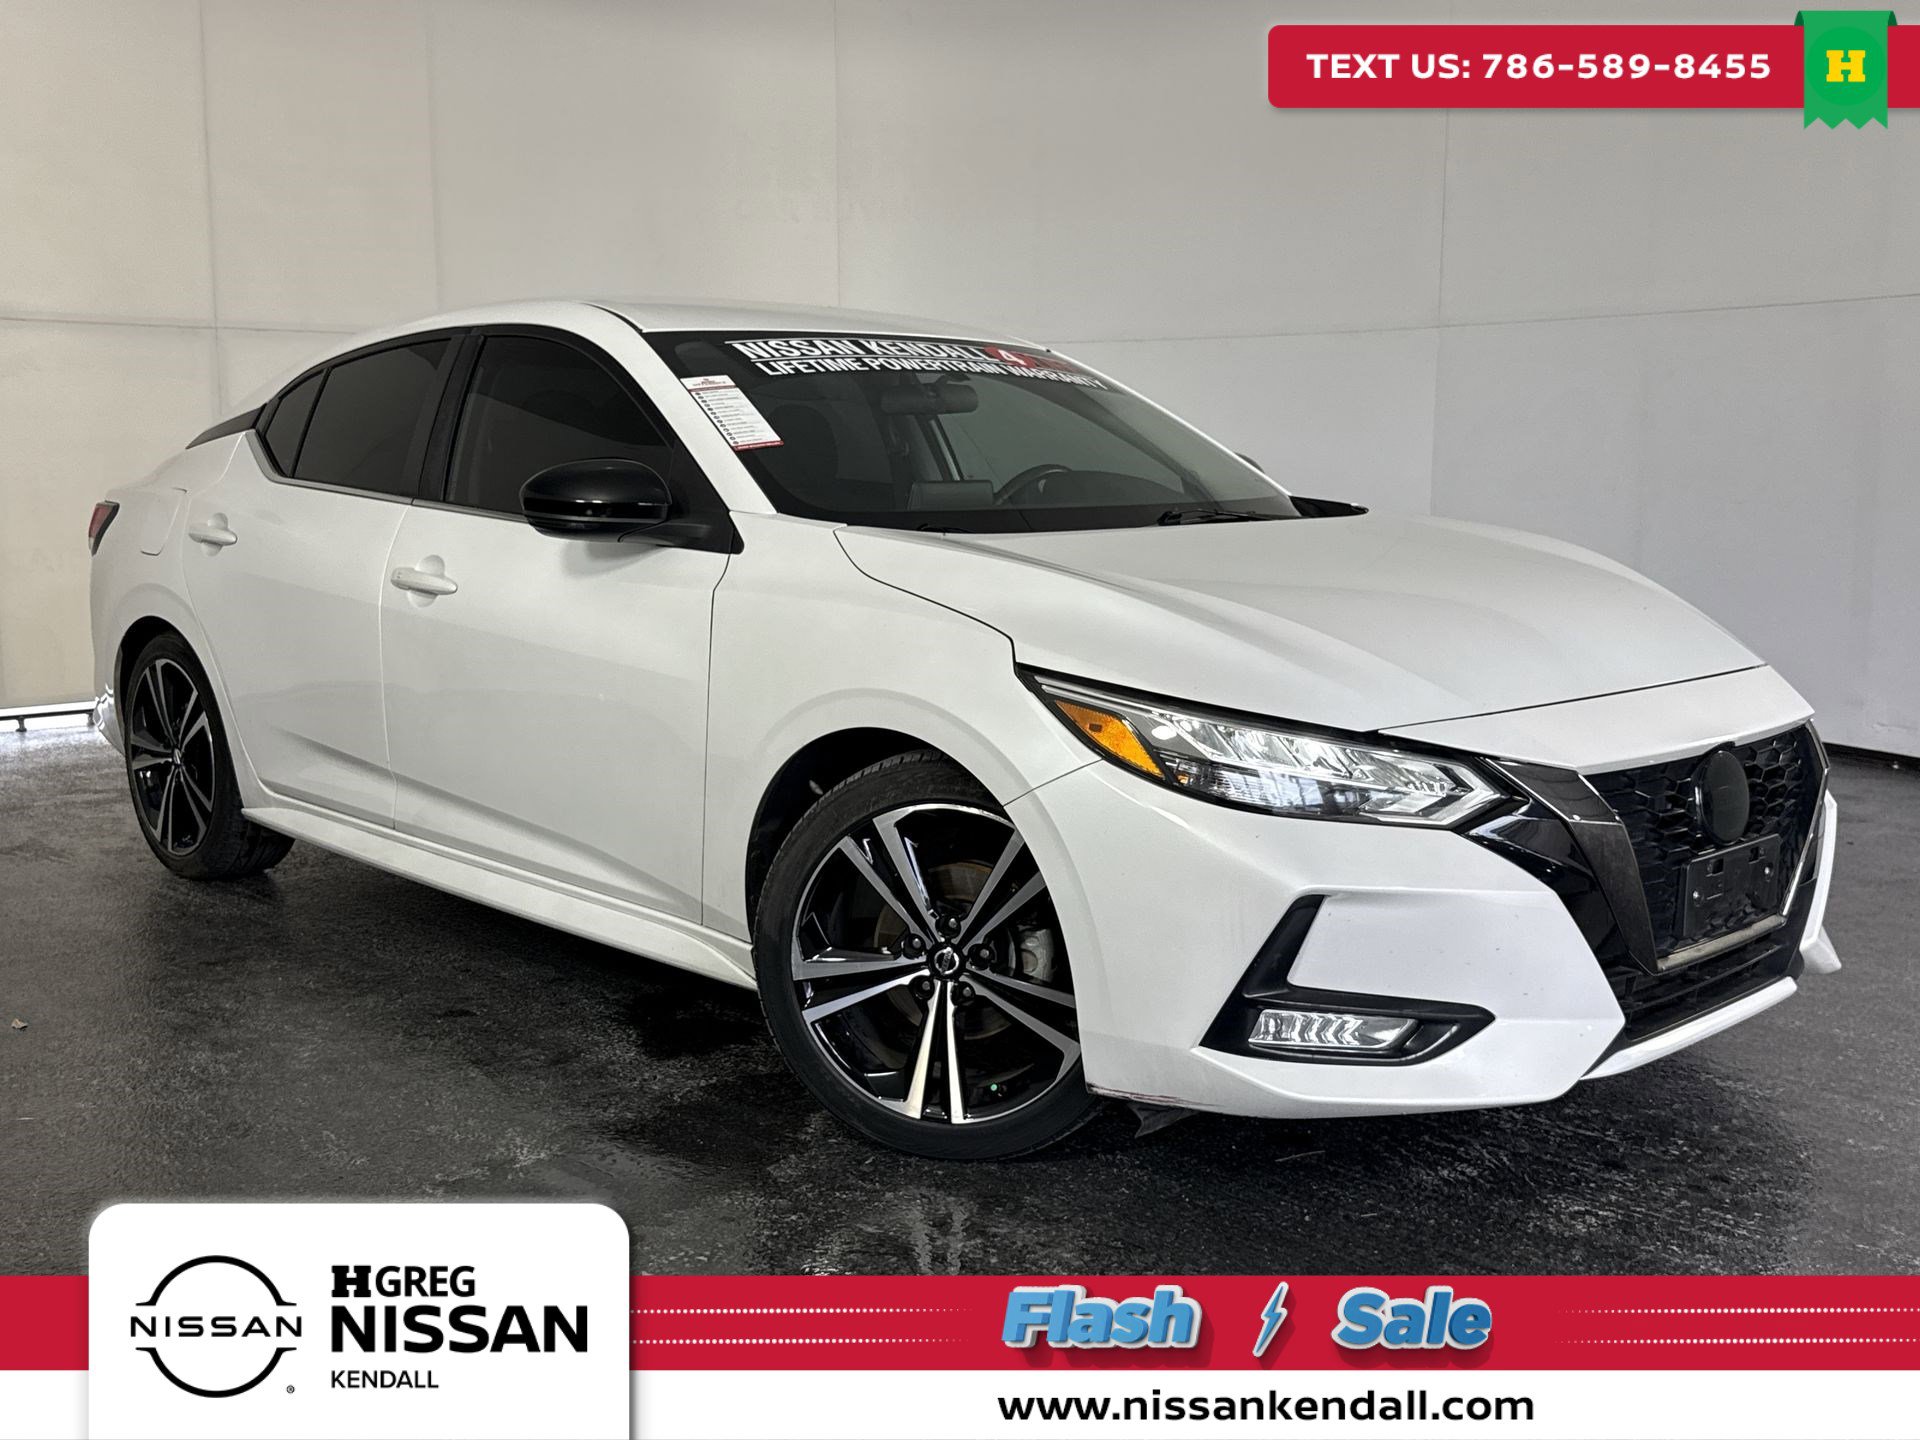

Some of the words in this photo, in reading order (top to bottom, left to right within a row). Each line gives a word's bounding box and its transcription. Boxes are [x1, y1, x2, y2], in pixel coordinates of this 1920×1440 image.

[732, 340, 865, 359] NISSAN
[859, 340, 1000, 362] KENDALL
[755, 357, 869, 376] LIFETIME
[862, 356, 1009, 376] POWERTRAIN
[1000, 363, 1108, 391] WARRANTY
